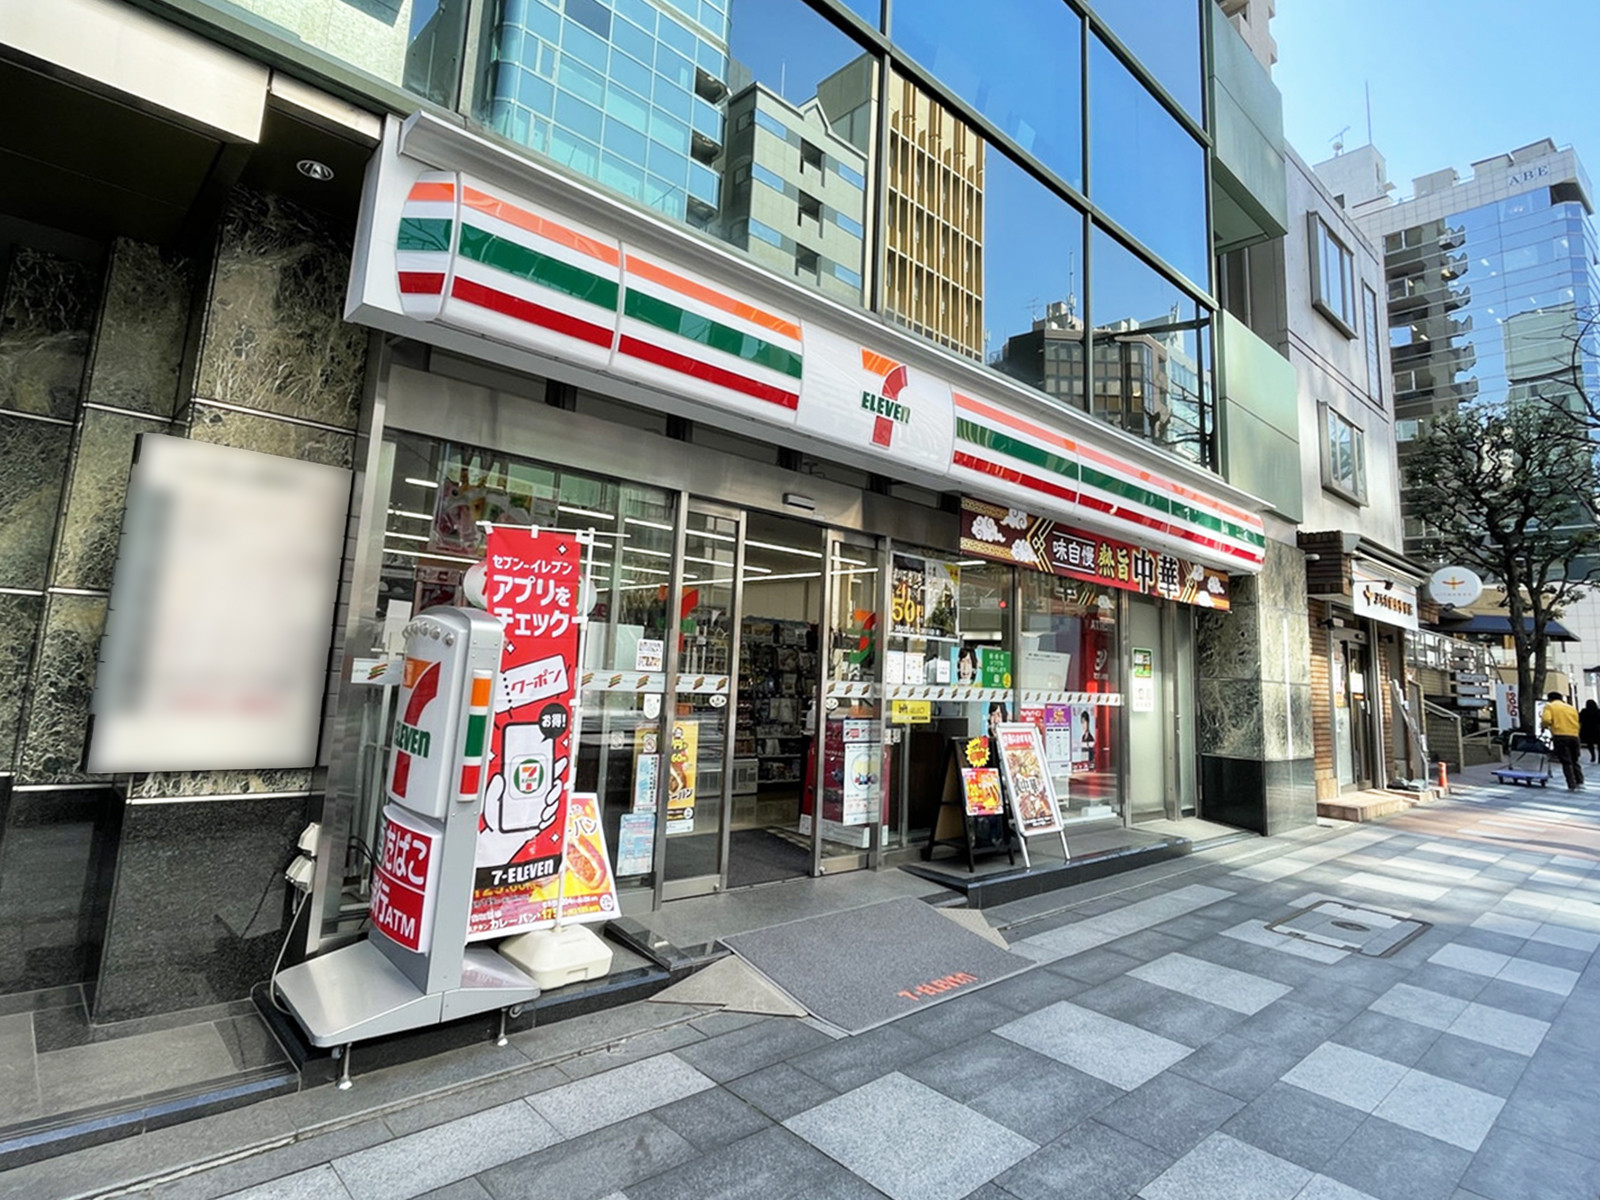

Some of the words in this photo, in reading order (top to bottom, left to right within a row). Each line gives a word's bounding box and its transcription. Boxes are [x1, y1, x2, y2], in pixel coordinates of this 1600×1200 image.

[1508, 165, 1549, 186] ABE
[1052, 538, 1095, 568] 味自慢
[492, 574, 572, 607] アプリを
[493, 606, 570, 638] チェック
[510, 668, 562, 698] クーポン
